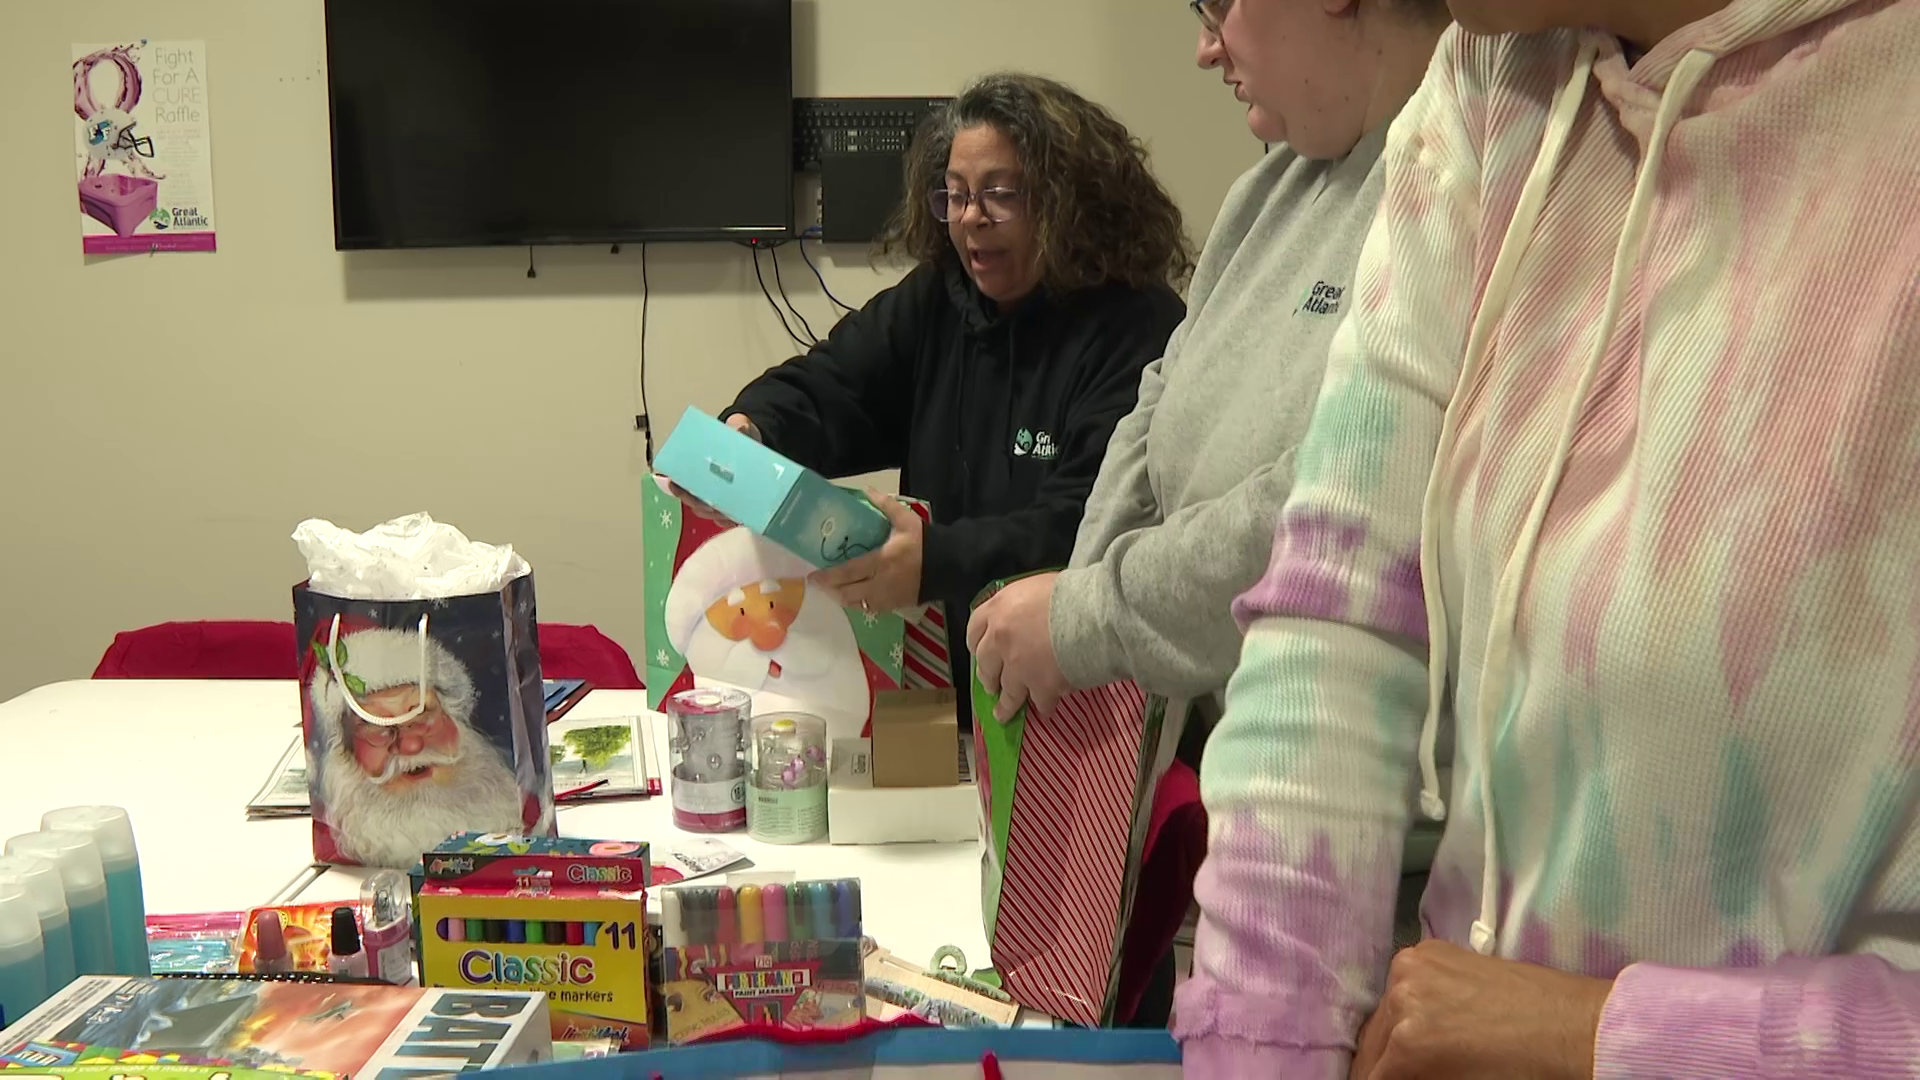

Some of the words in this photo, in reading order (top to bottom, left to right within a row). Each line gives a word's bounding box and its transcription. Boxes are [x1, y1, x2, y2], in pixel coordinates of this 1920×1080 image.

[155, 46, 193, 69] Fight
[153, 68, 179, 85] For
[184, 66, 199, 84] A
[152, 87, 202, 104] CURE
[155, 105, 200, 124] Raffle
[171, 206, 198, 216] Great
[172, 215, 208, 226] Atlantic
[516, 877, 530, 887] 11
[567, 863, 633, 884] Classic
[605, 921, 636, 950] 11
[459, 949, 597, 986] Classic
[560, 990, 613, 1003] markers
